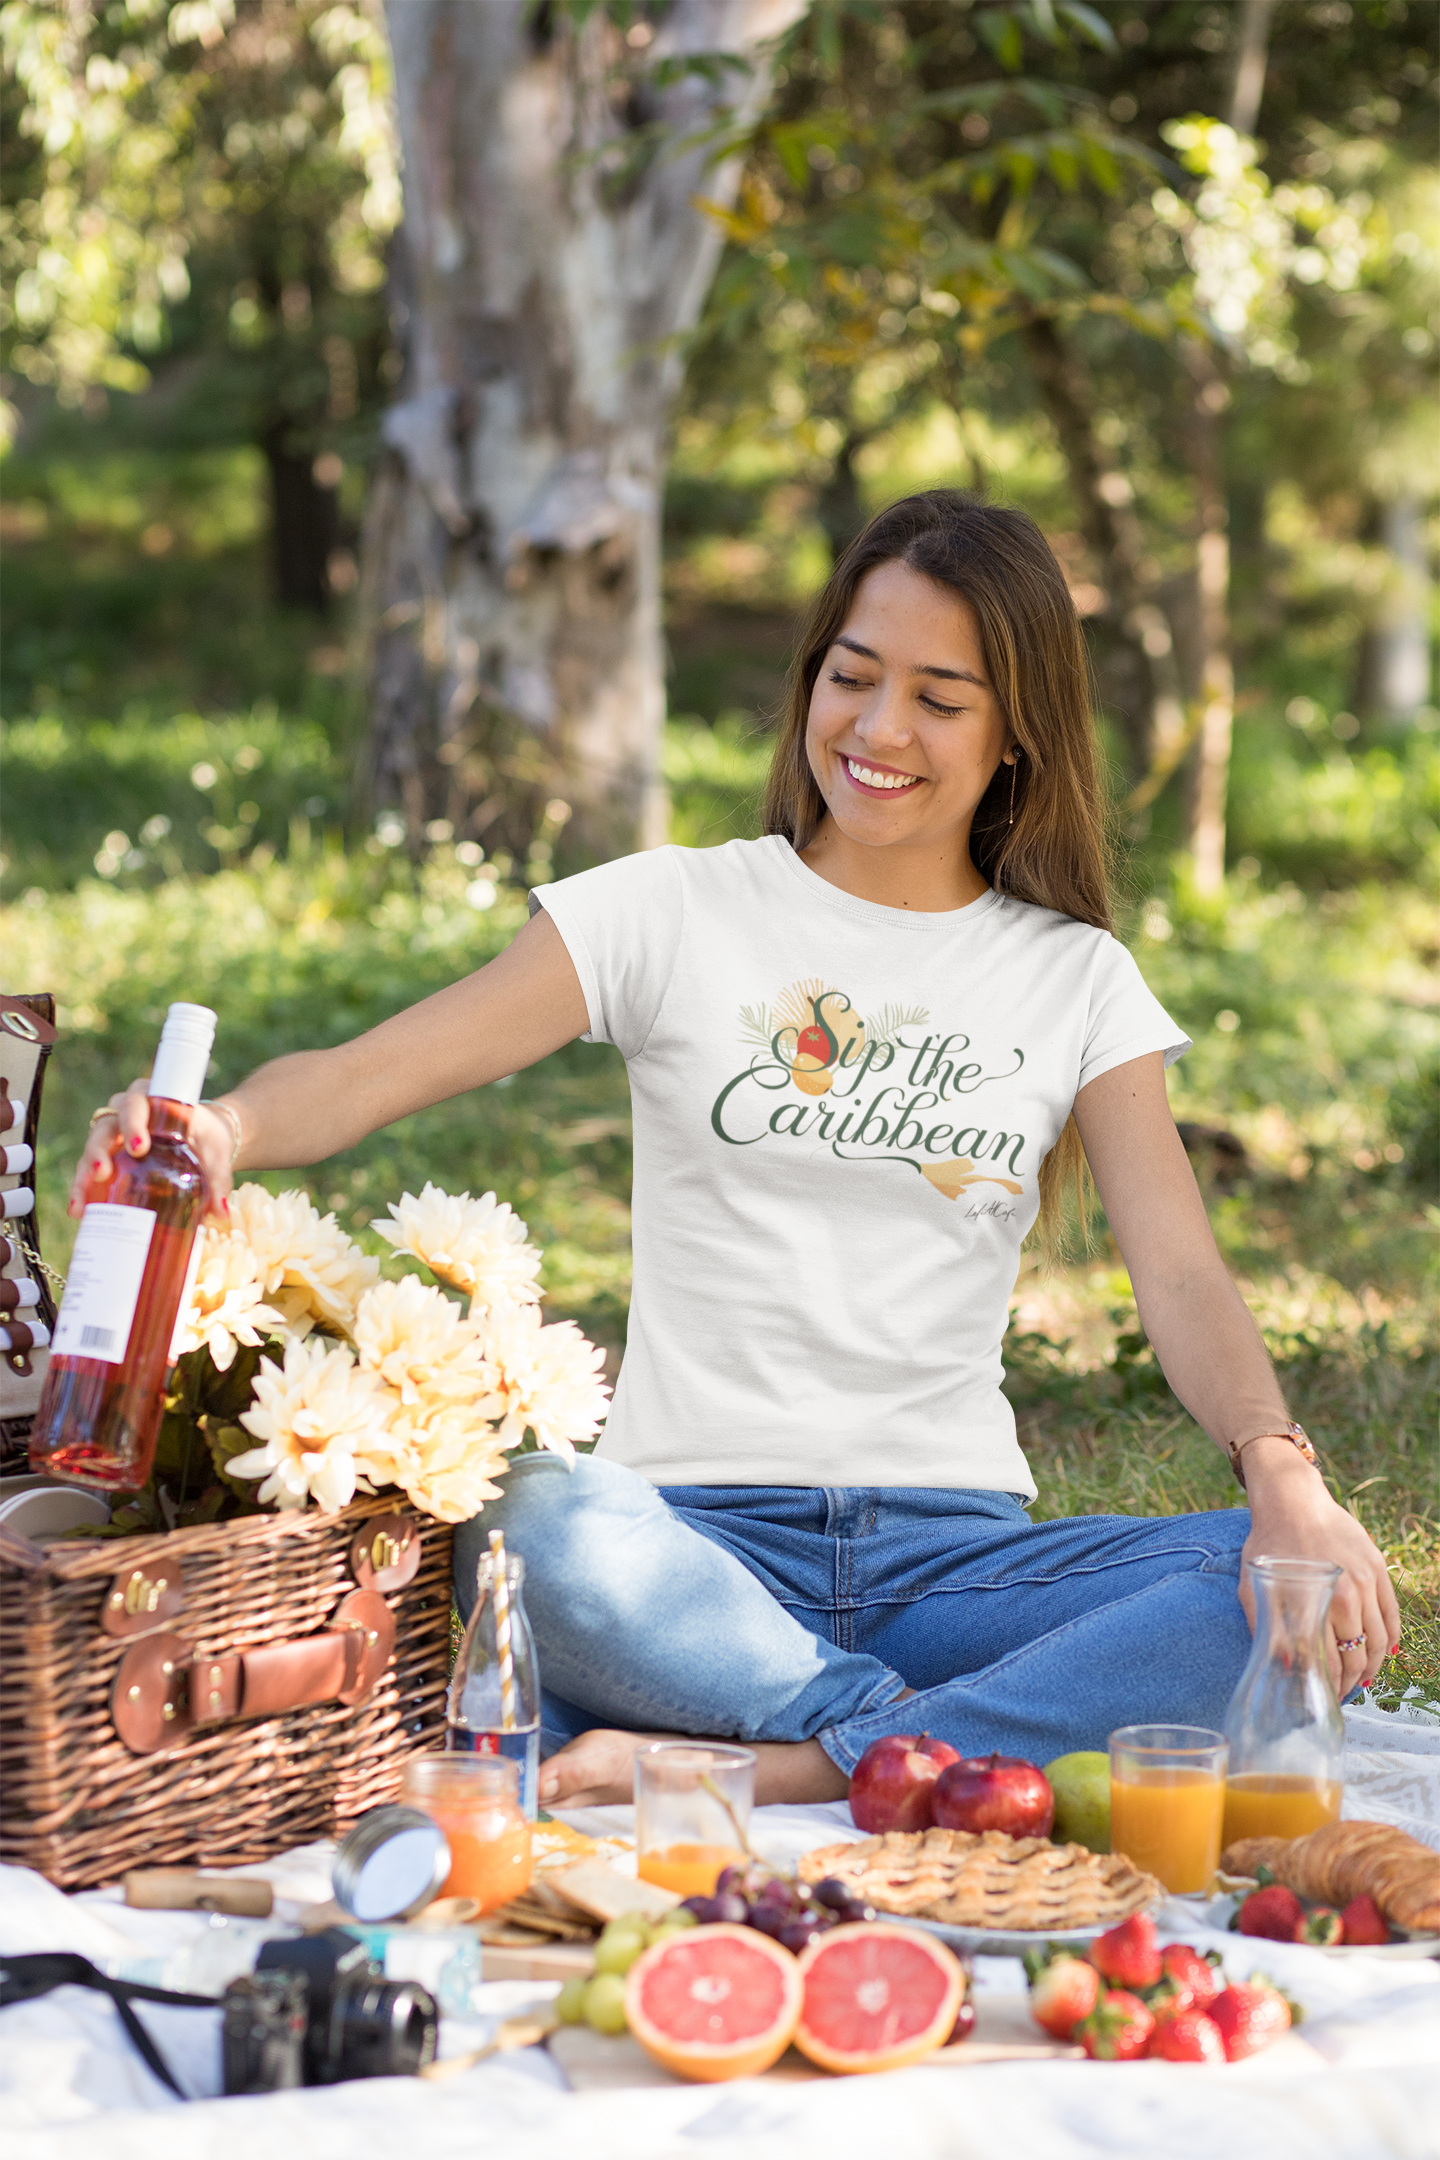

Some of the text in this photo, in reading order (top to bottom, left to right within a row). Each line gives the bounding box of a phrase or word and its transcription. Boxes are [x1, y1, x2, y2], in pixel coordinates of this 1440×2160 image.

[771, 991, 1024, 1101] Sip the
[710, 1054, 1025, 1177] Caribbean
